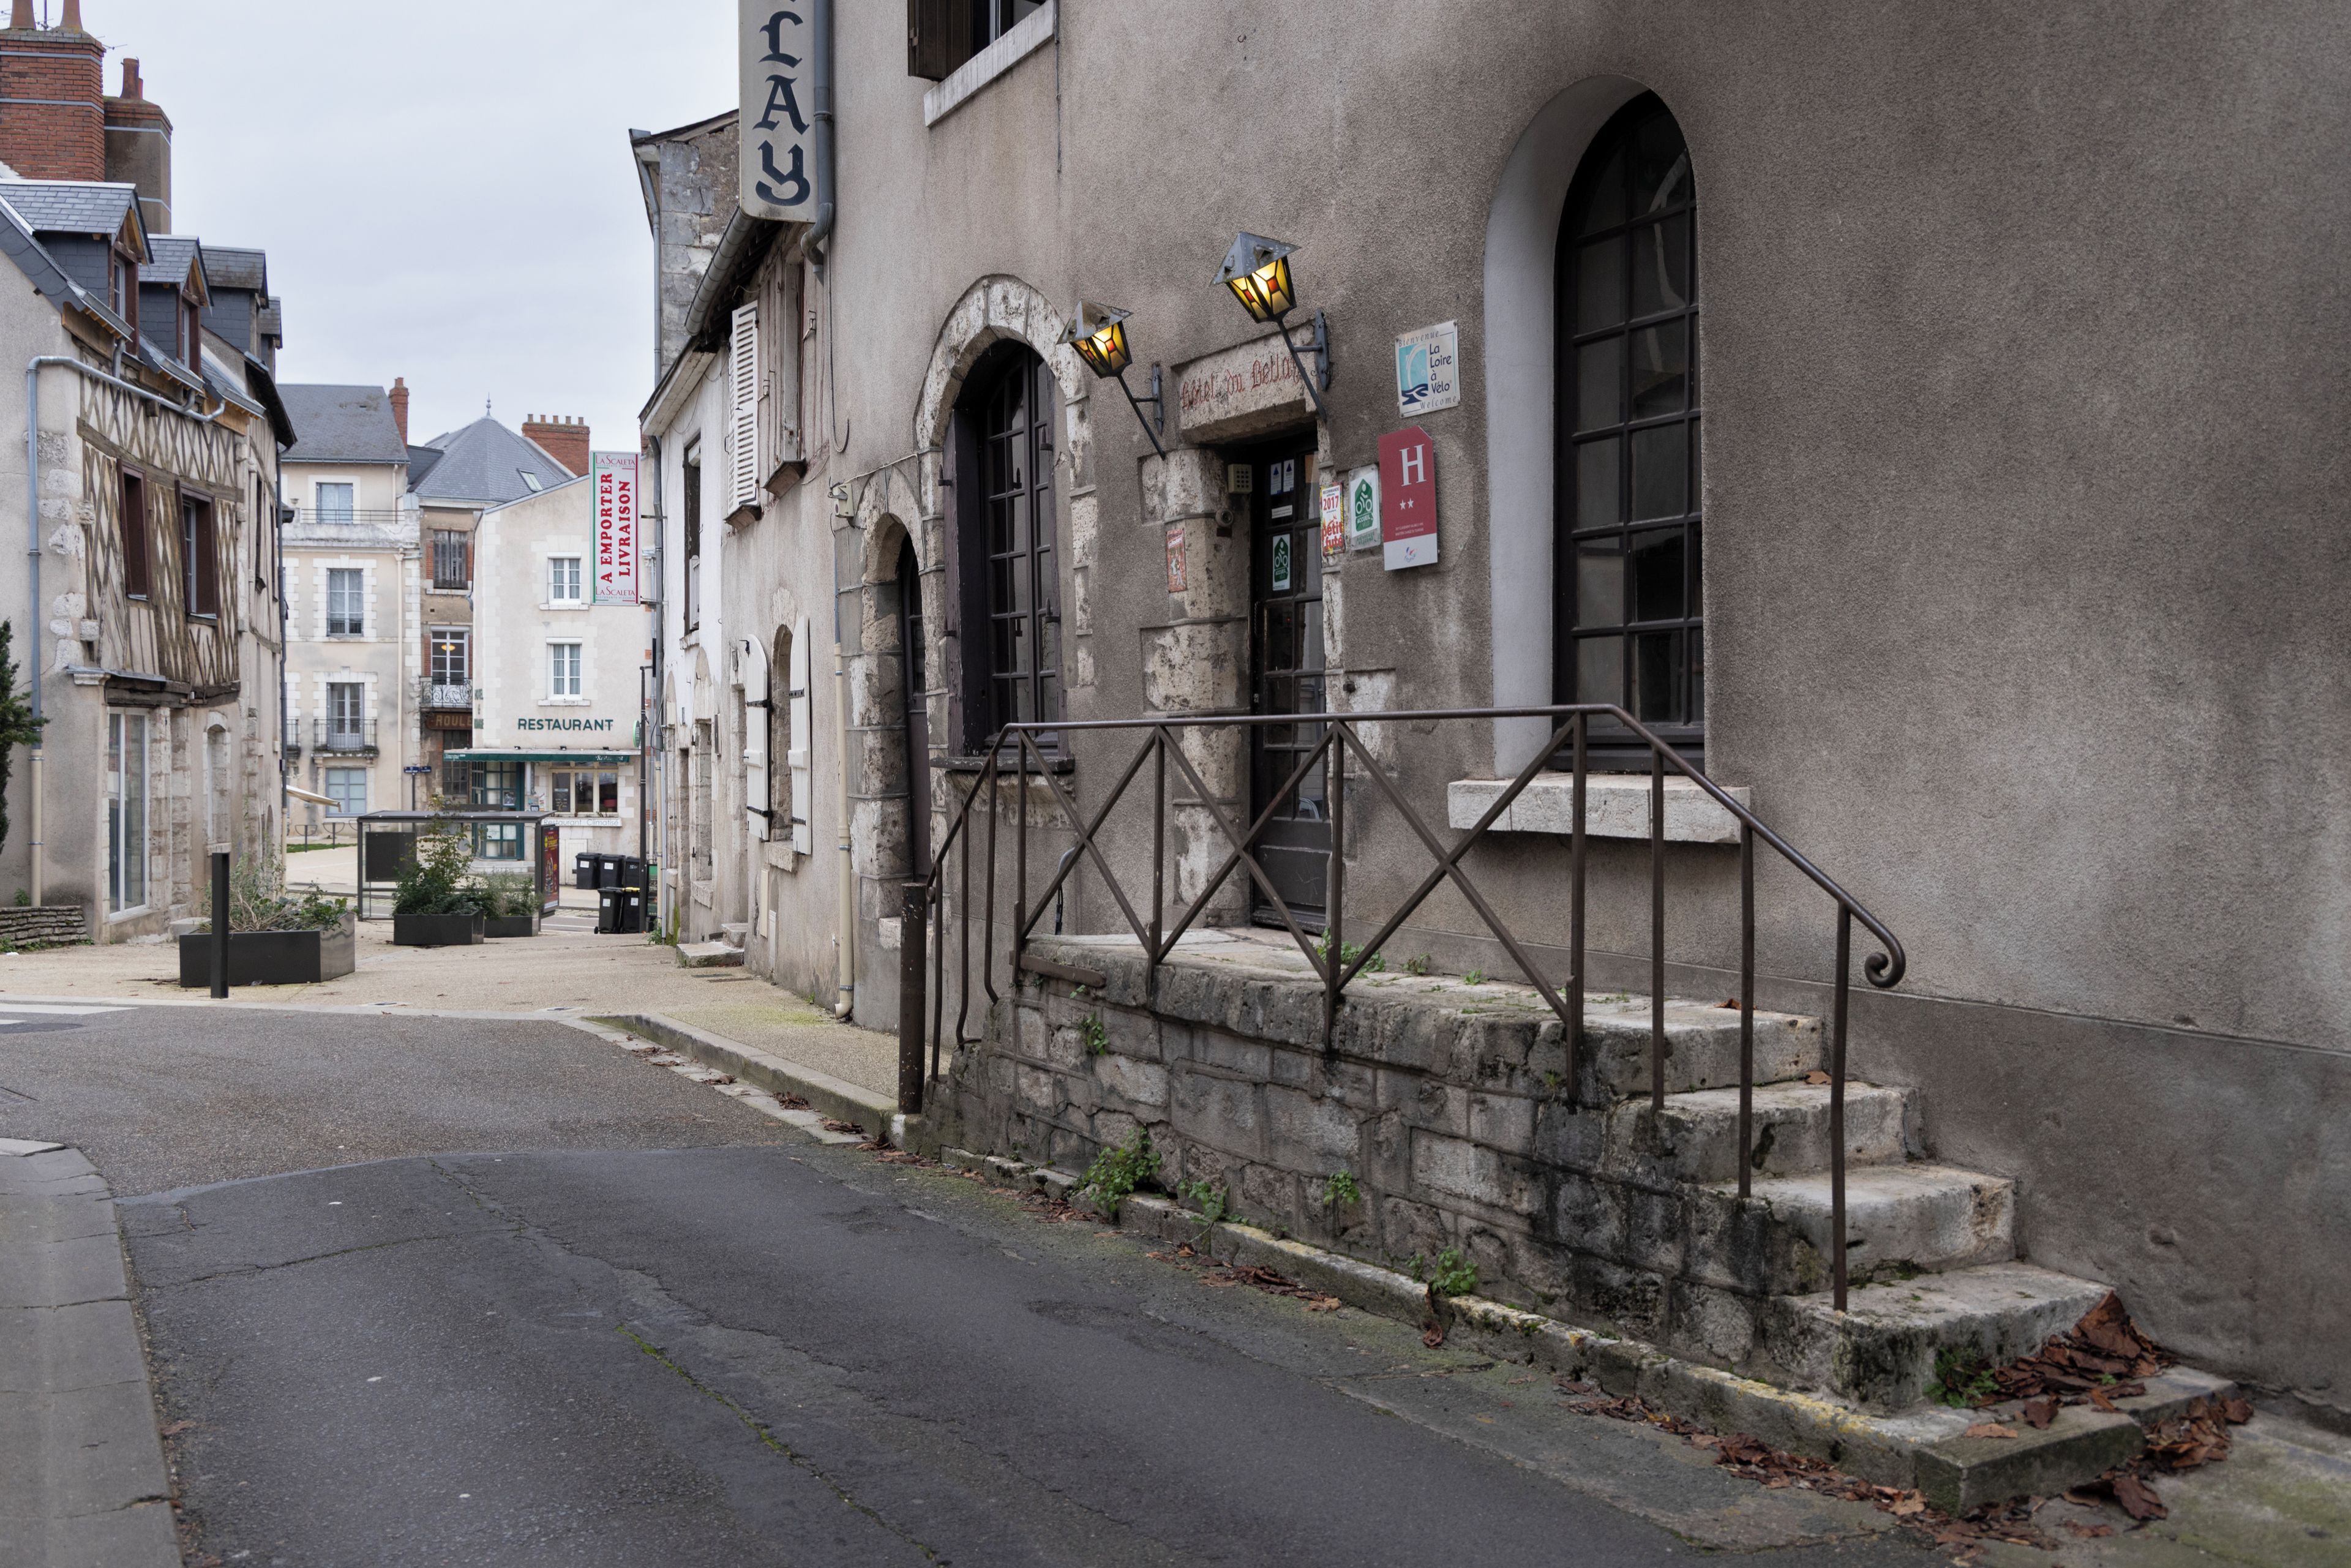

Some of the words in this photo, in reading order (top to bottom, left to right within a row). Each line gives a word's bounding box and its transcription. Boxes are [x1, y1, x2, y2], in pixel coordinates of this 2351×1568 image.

[752, 0, 810, 206] LAY
[1398, 331, 1439, 347] Bienvenue
[1430, 343, 1439, 355] La
[1430, 355, 1452, 368] Loire
[1226, 369, 1245, 396] du
[1430, 370, 1437, 381] à
[1420, 396, 1458, 410] Welcome
[1399, 444, 1427, 487] H
[1323, 495, 1339, 511] 2017
[601, 473, 612, 566] EMPORTER
[1357, 515, 1371, 523] ACCUEIL
[619, 481, 631, 577] LIVRAISON
[1322, 520, 1343, 541] petit
[1325, 536, 1343, 549] futé
[601, 572, 612, 583] A
[518, 718, 613, 731] RESTAURANT
